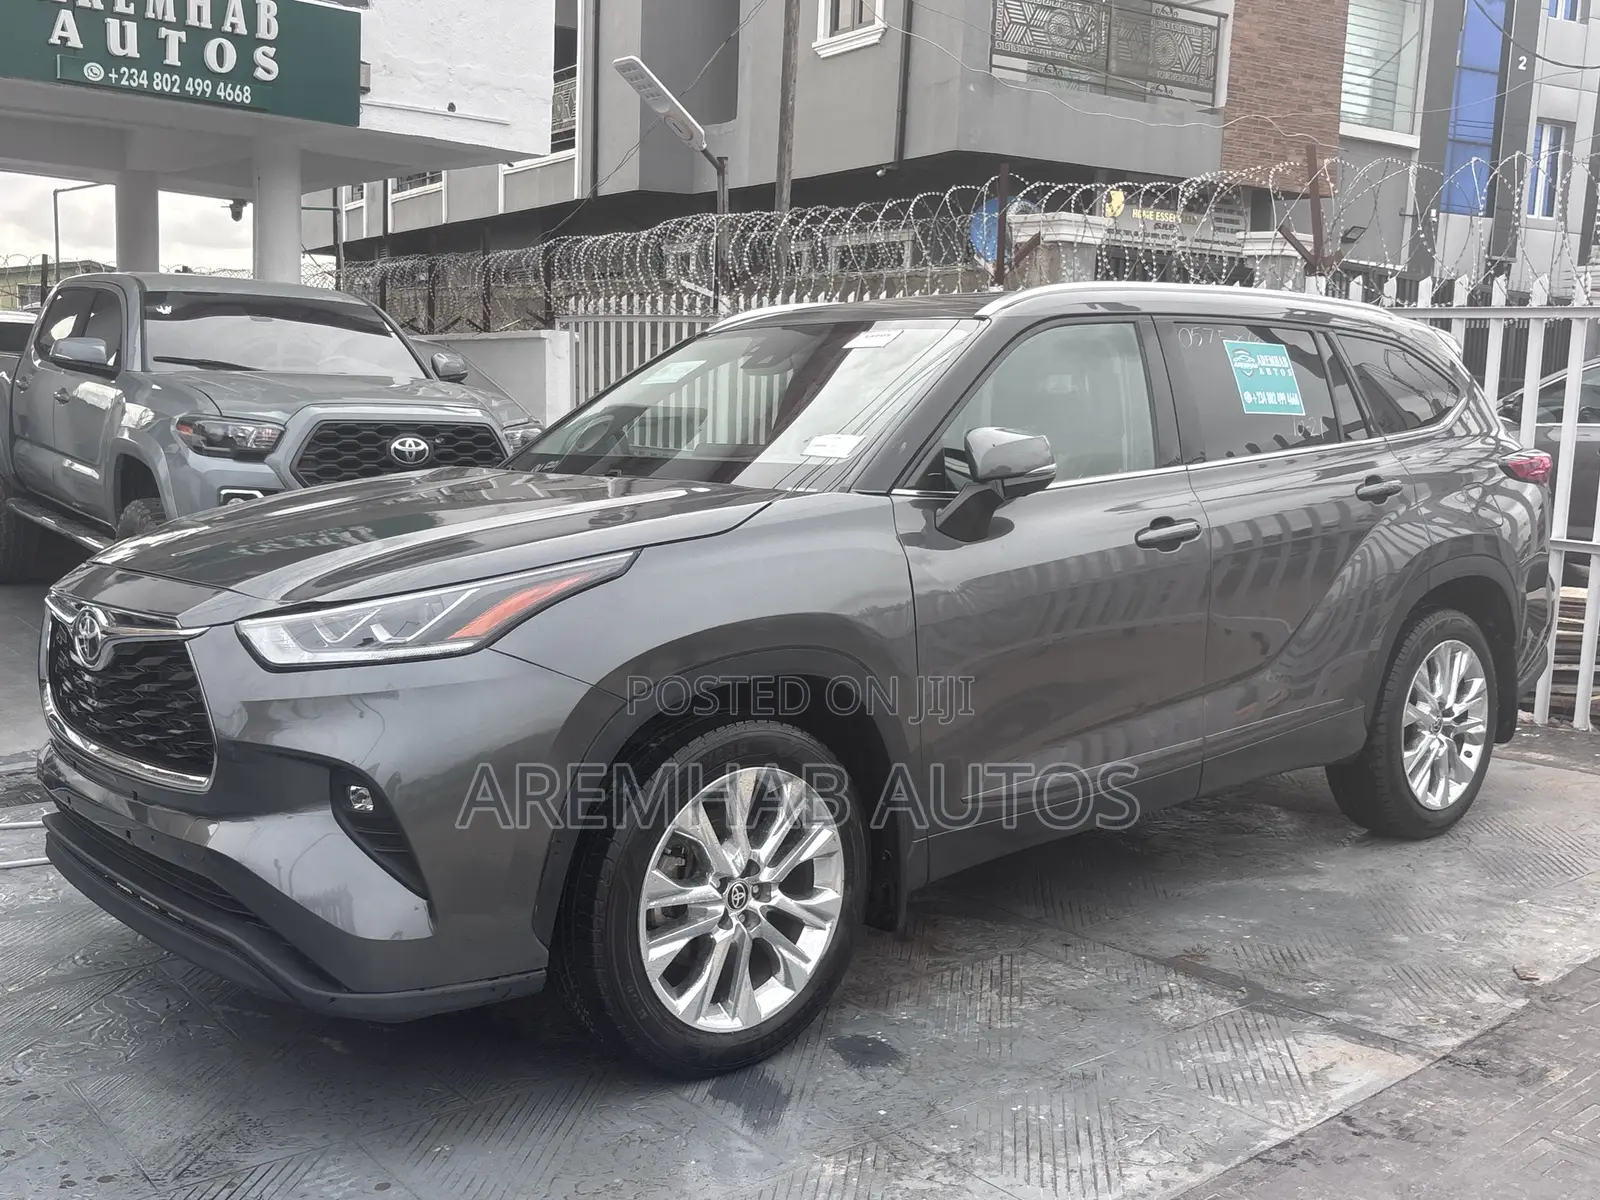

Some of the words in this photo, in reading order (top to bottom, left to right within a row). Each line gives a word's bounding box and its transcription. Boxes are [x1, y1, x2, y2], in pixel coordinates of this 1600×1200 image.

[40, 0, 280, 40] MHAB
[48, 9, 280, 81] AUTOS
[1518, 55, 1527, 71] 2
[108, 67, 149, 89] +234
[152, 72, 181, 94] 802
[185, 78, 212, 98] 499
[216, 82, 251, 104] 4668
